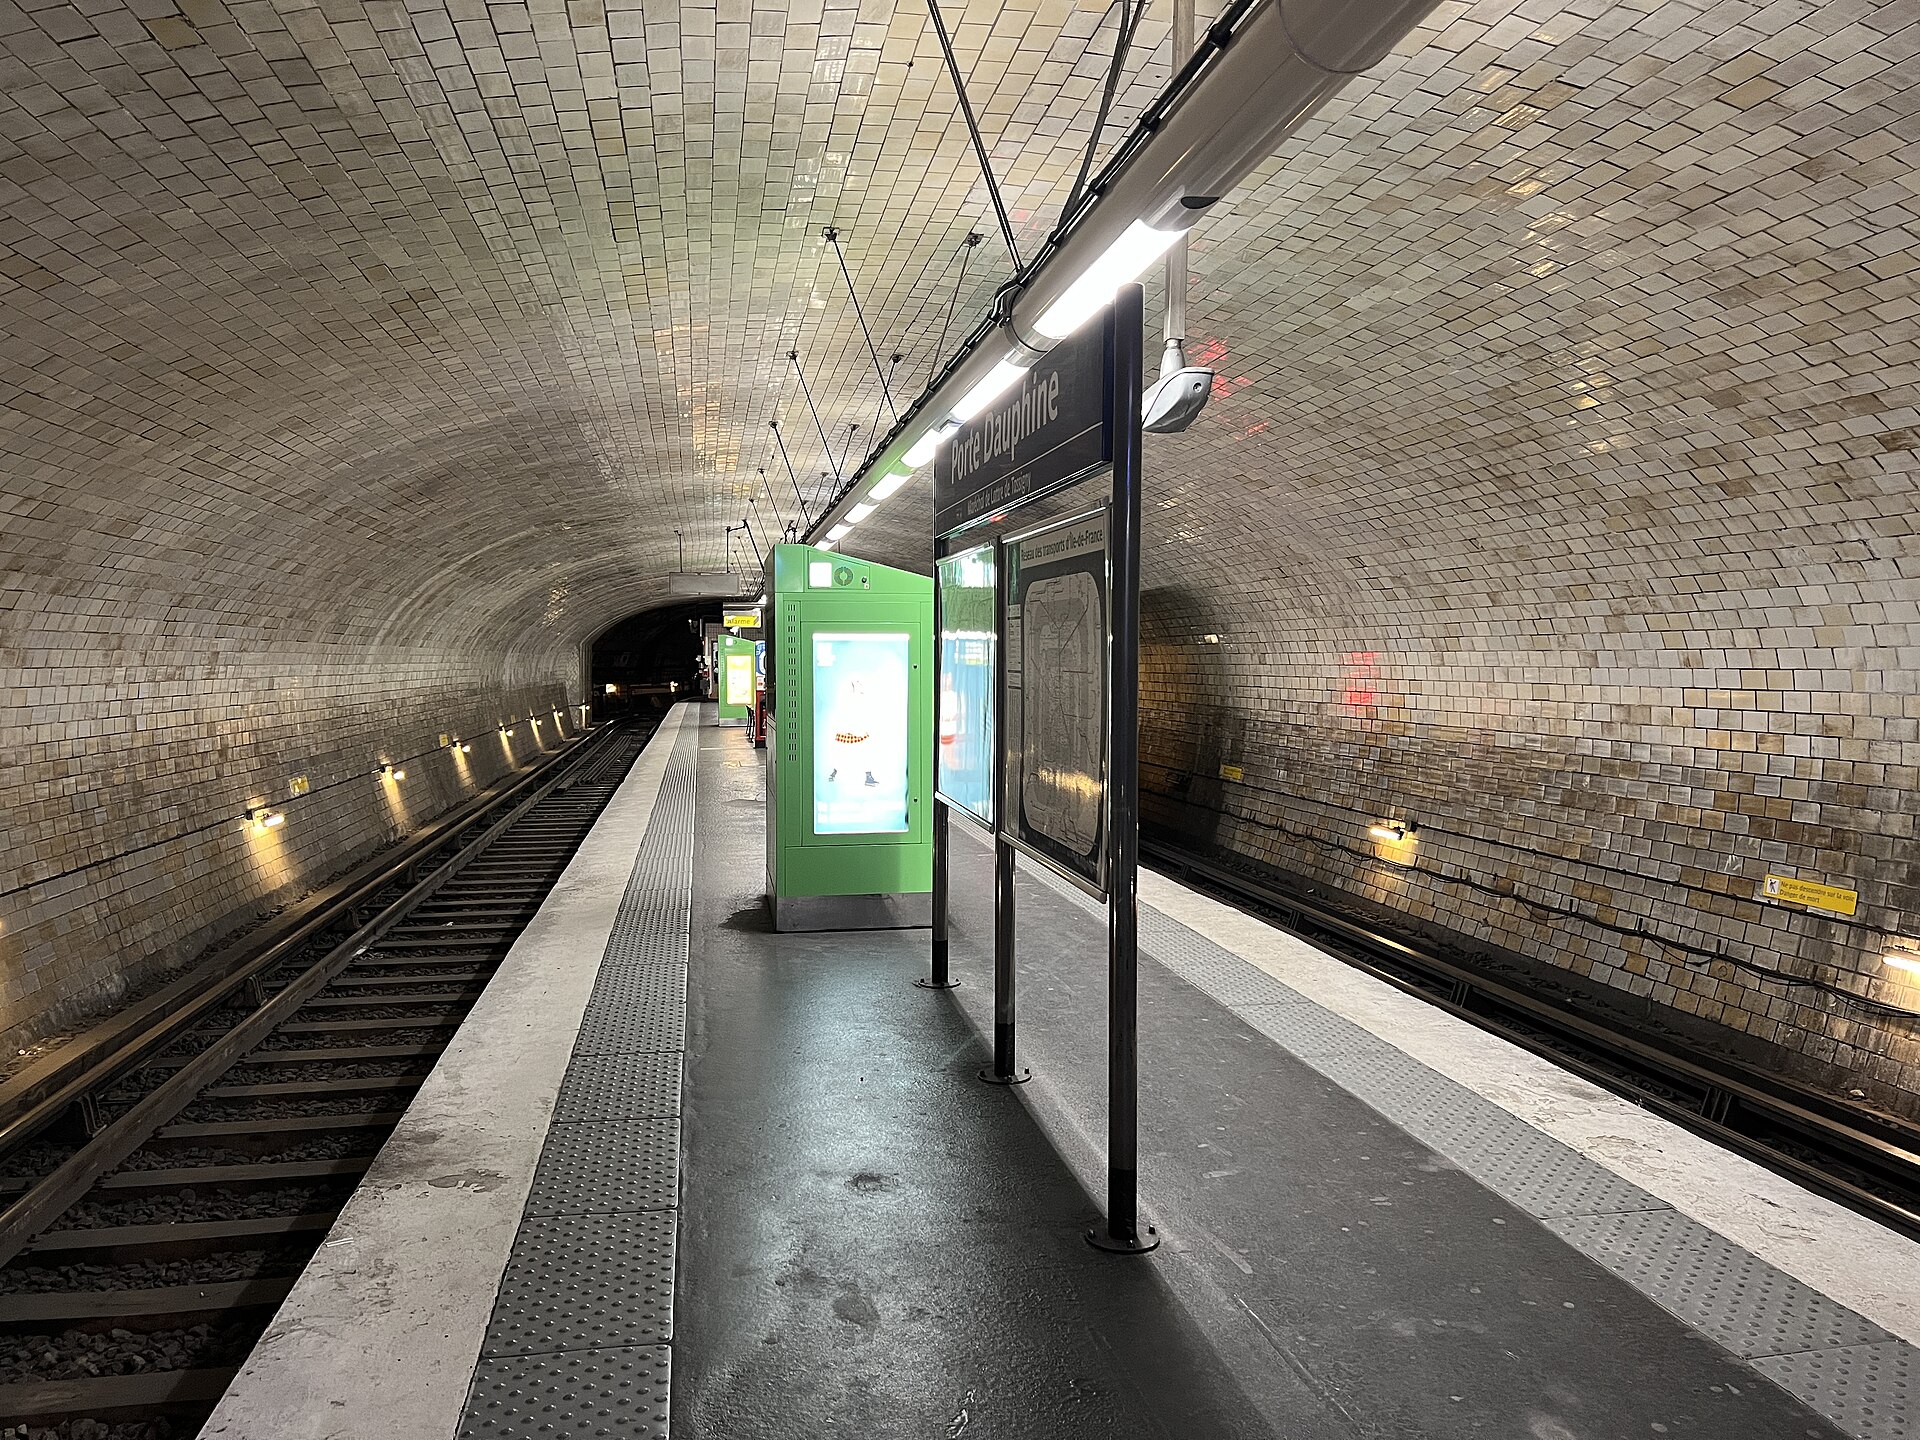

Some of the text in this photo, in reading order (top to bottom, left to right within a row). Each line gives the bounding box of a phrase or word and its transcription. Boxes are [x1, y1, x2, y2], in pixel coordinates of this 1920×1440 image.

[951, 370, 1059, 485] Porte Dauphine
[1780, 881, 1855, 903] Ne pas descendre sur la voie
[1780, 889, 1820, 904] Danger de mort
